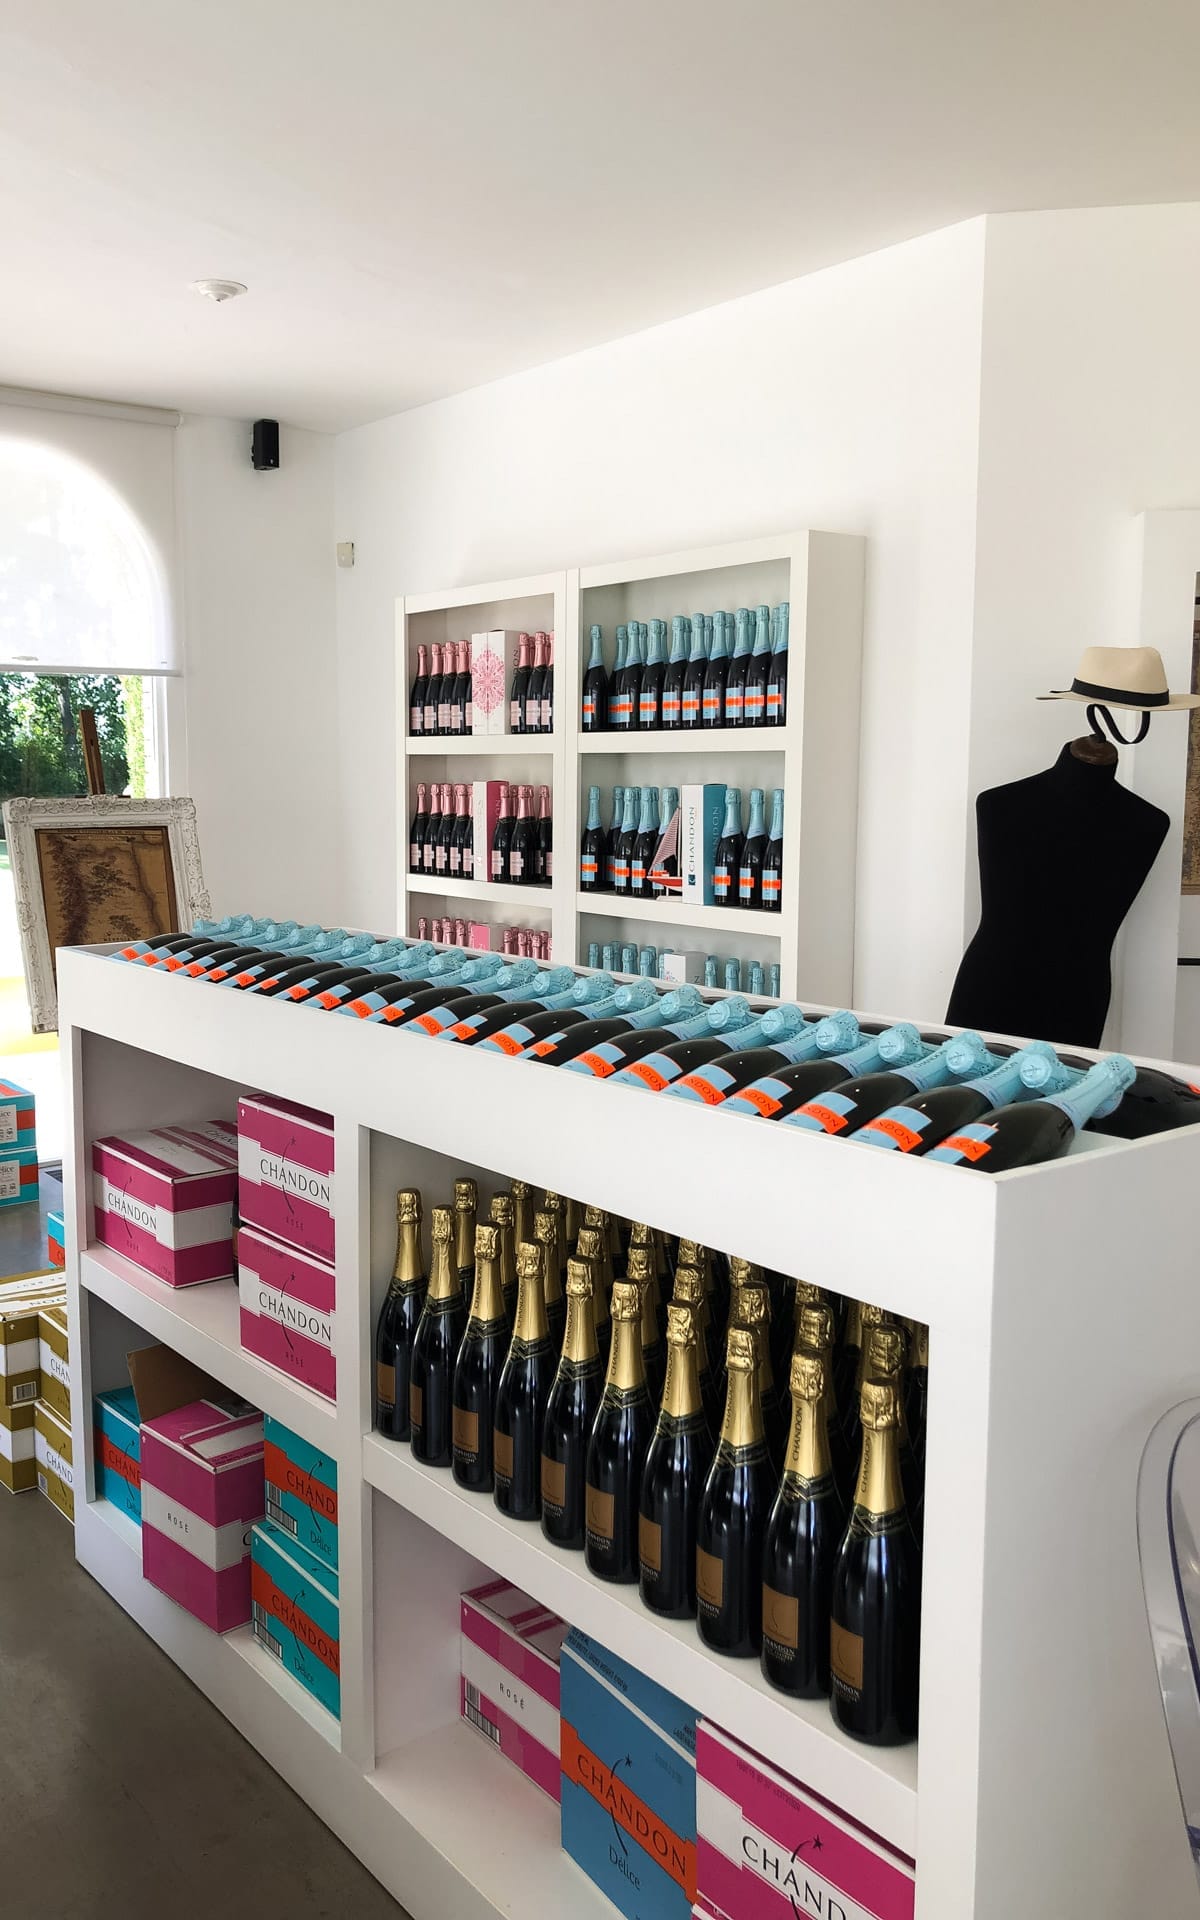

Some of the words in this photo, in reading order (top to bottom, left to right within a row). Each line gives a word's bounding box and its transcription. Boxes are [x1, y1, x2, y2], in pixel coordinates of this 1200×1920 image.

[260, 1158, 331, 1203] CHANDON
[107, 1191, 157, 1230] CHANDON
[258, 1290, 332, 1342] CHANDON
[611, 1328, 619, 1376] CHANDON
[792, 1406, 803, 1462] CHANDON
[46, 1450, 73, 1484] CHAND
[860, 1435, 871, 1494] CHANDON
[286, 1470, 336, 1515] CHAND
[271, 1594, 339, 1668] CHANDON
[577, 1754, 687, 1878] CHANDON
[608, 1843, 641, 1892] Délice
[742, 1835, 847, 1920] CHAND
